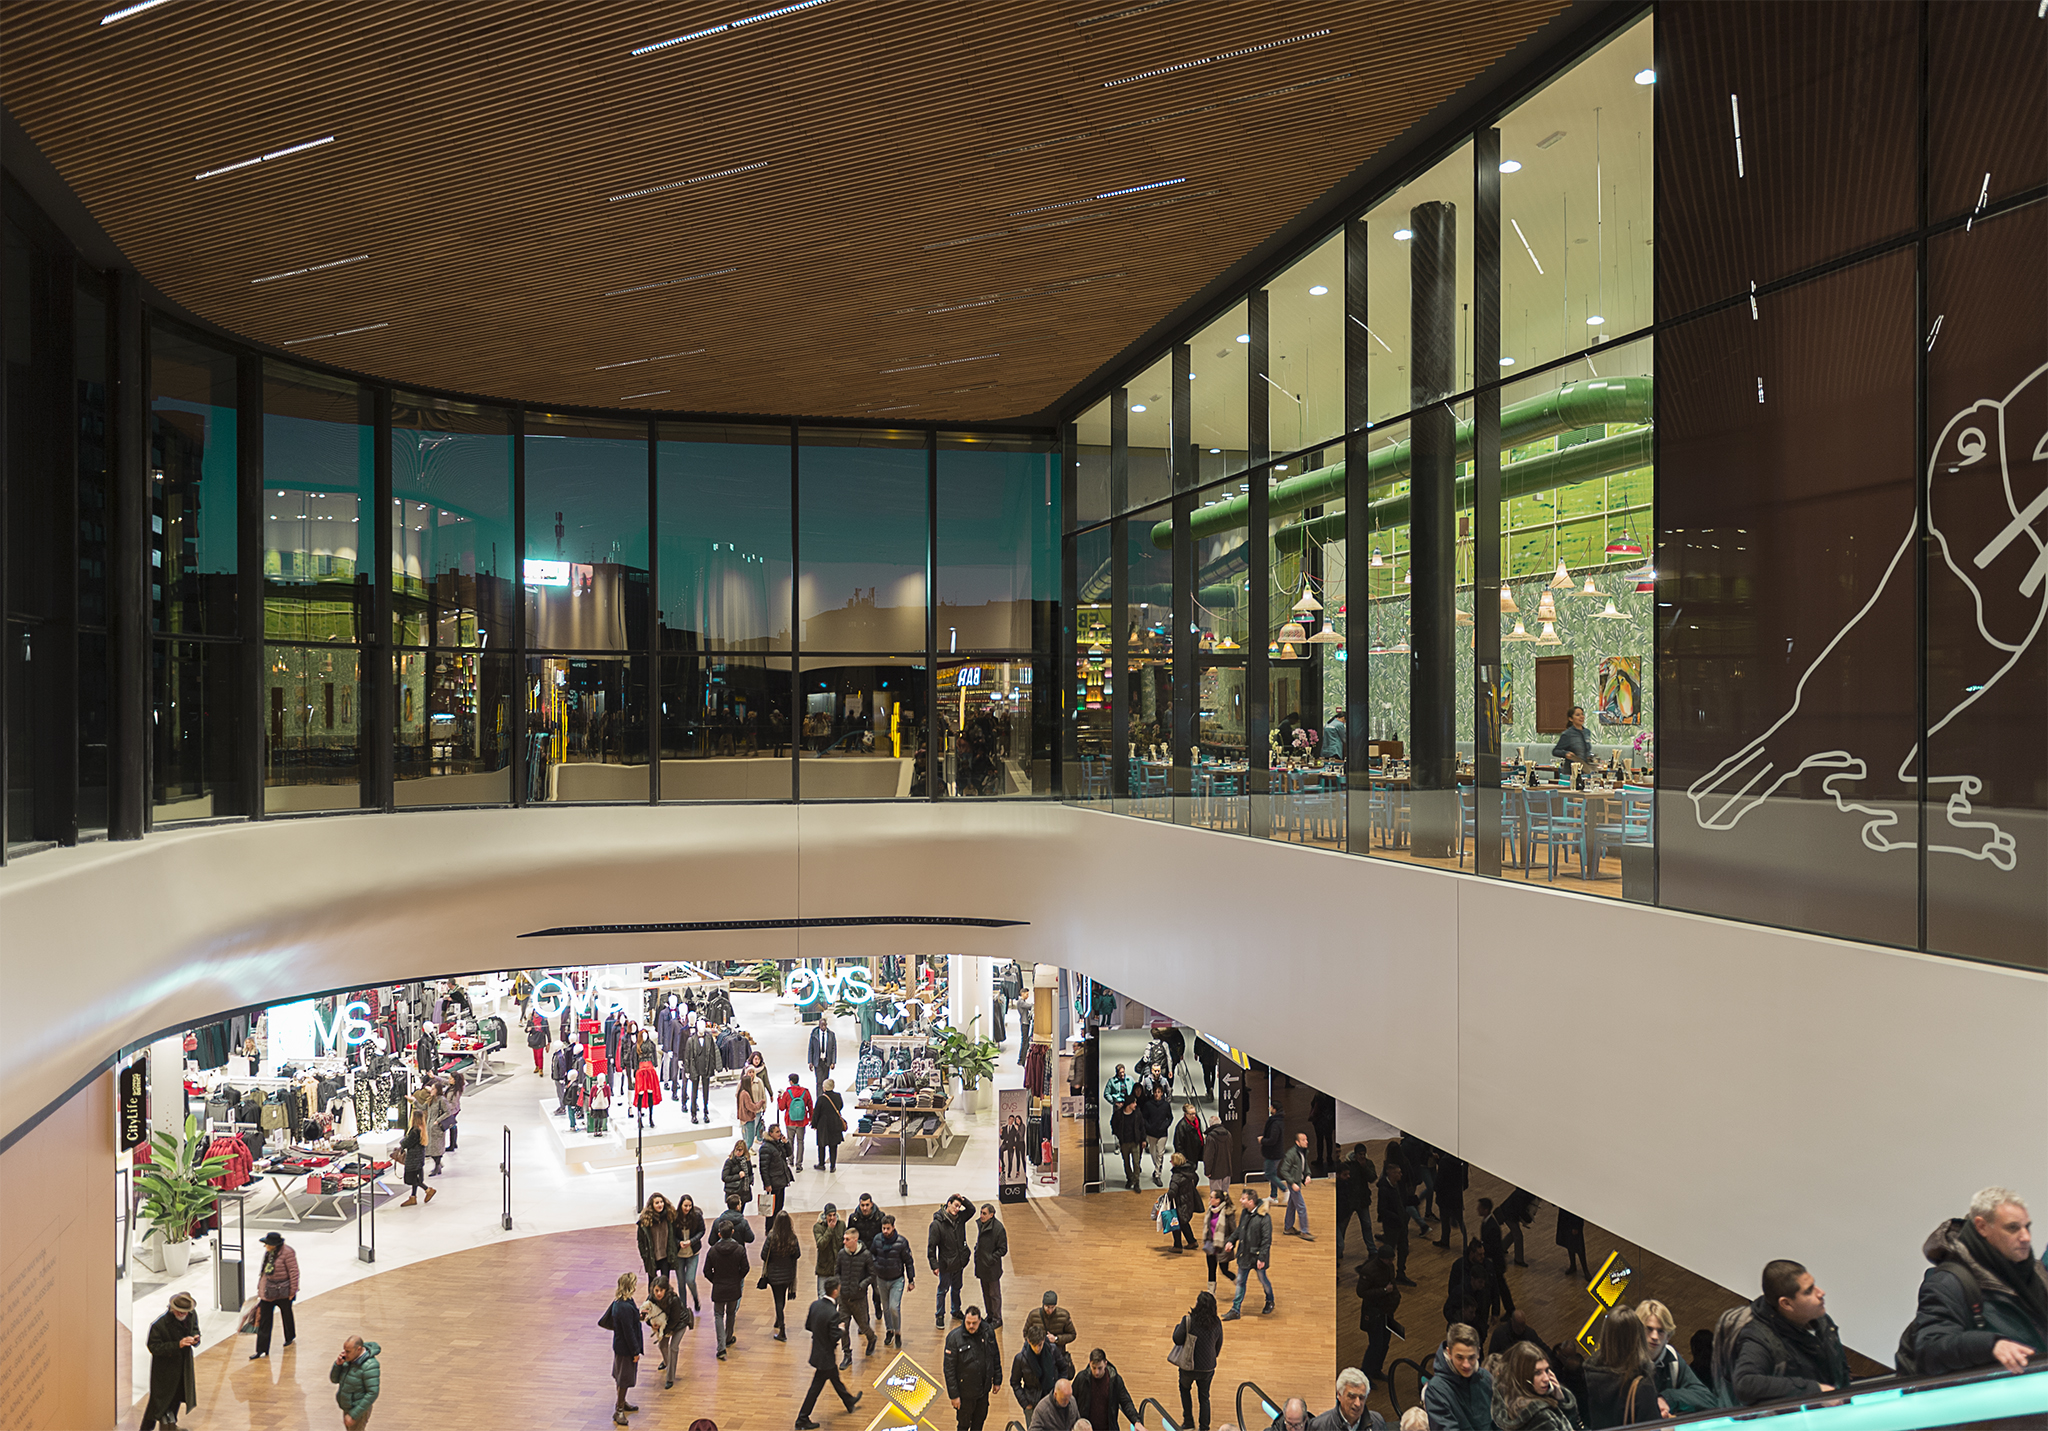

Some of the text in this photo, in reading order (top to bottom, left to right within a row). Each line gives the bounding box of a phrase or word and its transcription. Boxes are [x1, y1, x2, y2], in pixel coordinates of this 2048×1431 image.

[532, 973, 627, 1018] OVS
[786, 966, 873, 1006] OVS
[126, 1097, 141, 1142] CityLife
[1001, 1102, 1018, 1110] OVS
[1004, 1187, 1021, 1196] OVS
